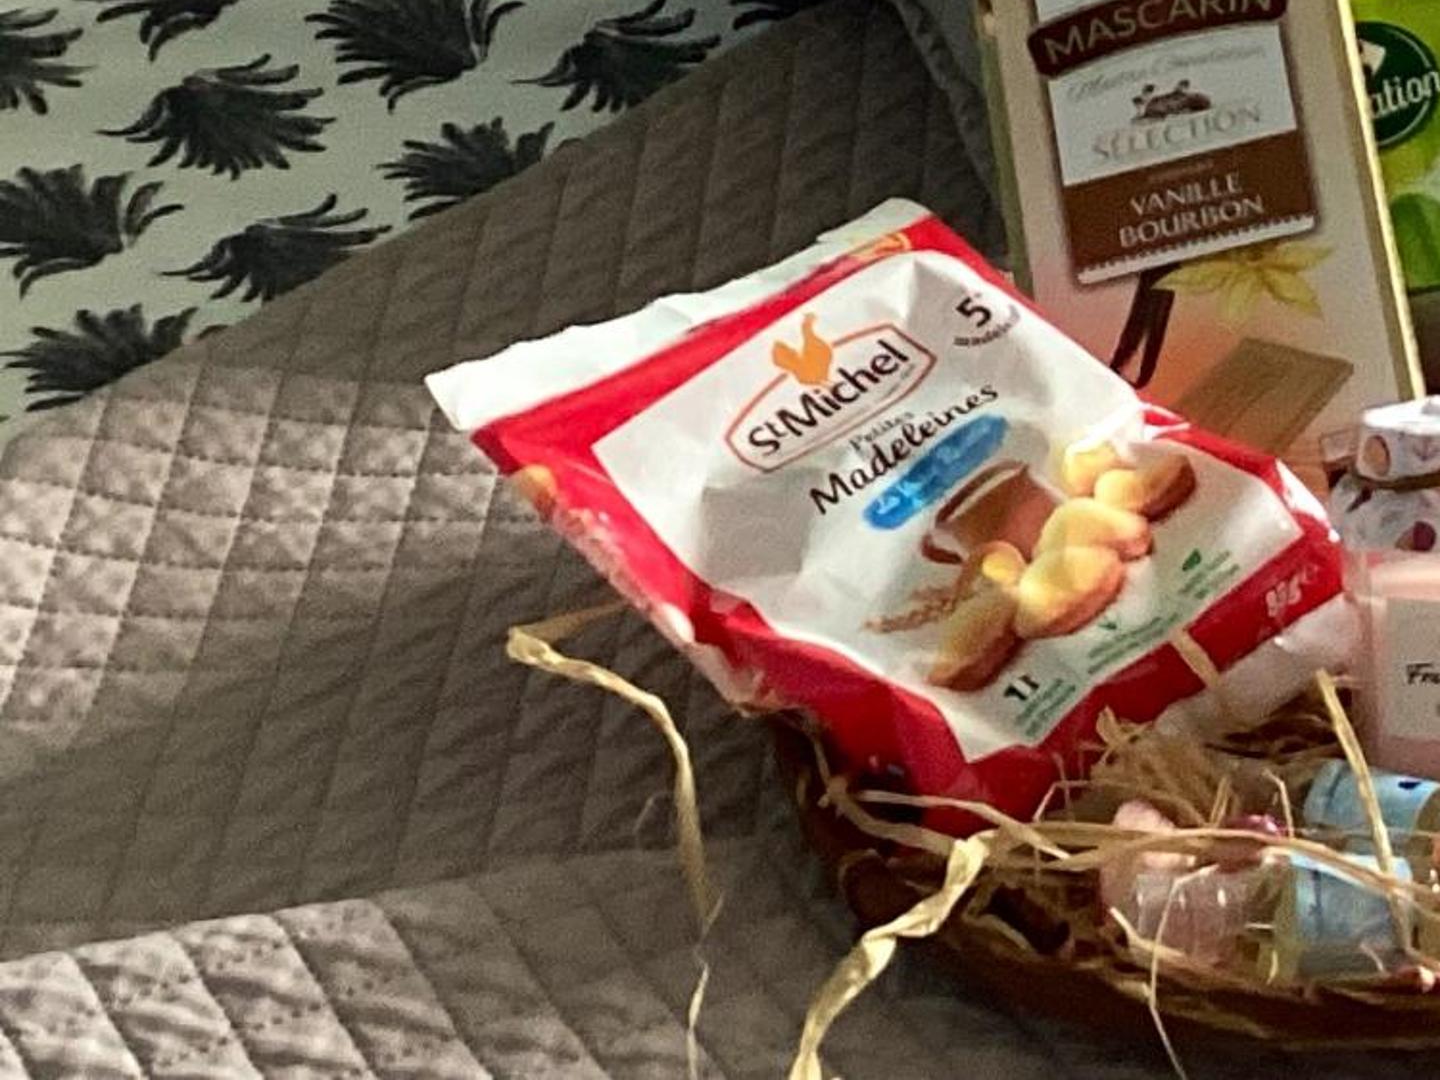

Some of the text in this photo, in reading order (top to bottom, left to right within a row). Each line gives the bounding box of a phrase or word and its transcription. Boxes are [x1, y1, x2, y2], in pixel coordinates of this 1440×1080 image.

[1130, 170, 1244, 216] VANILLE
[1118, 193, 1265, 248] BOURBON
[955, 296, 992, 329] 5
[808, 384, 999, 516] Madeleines
